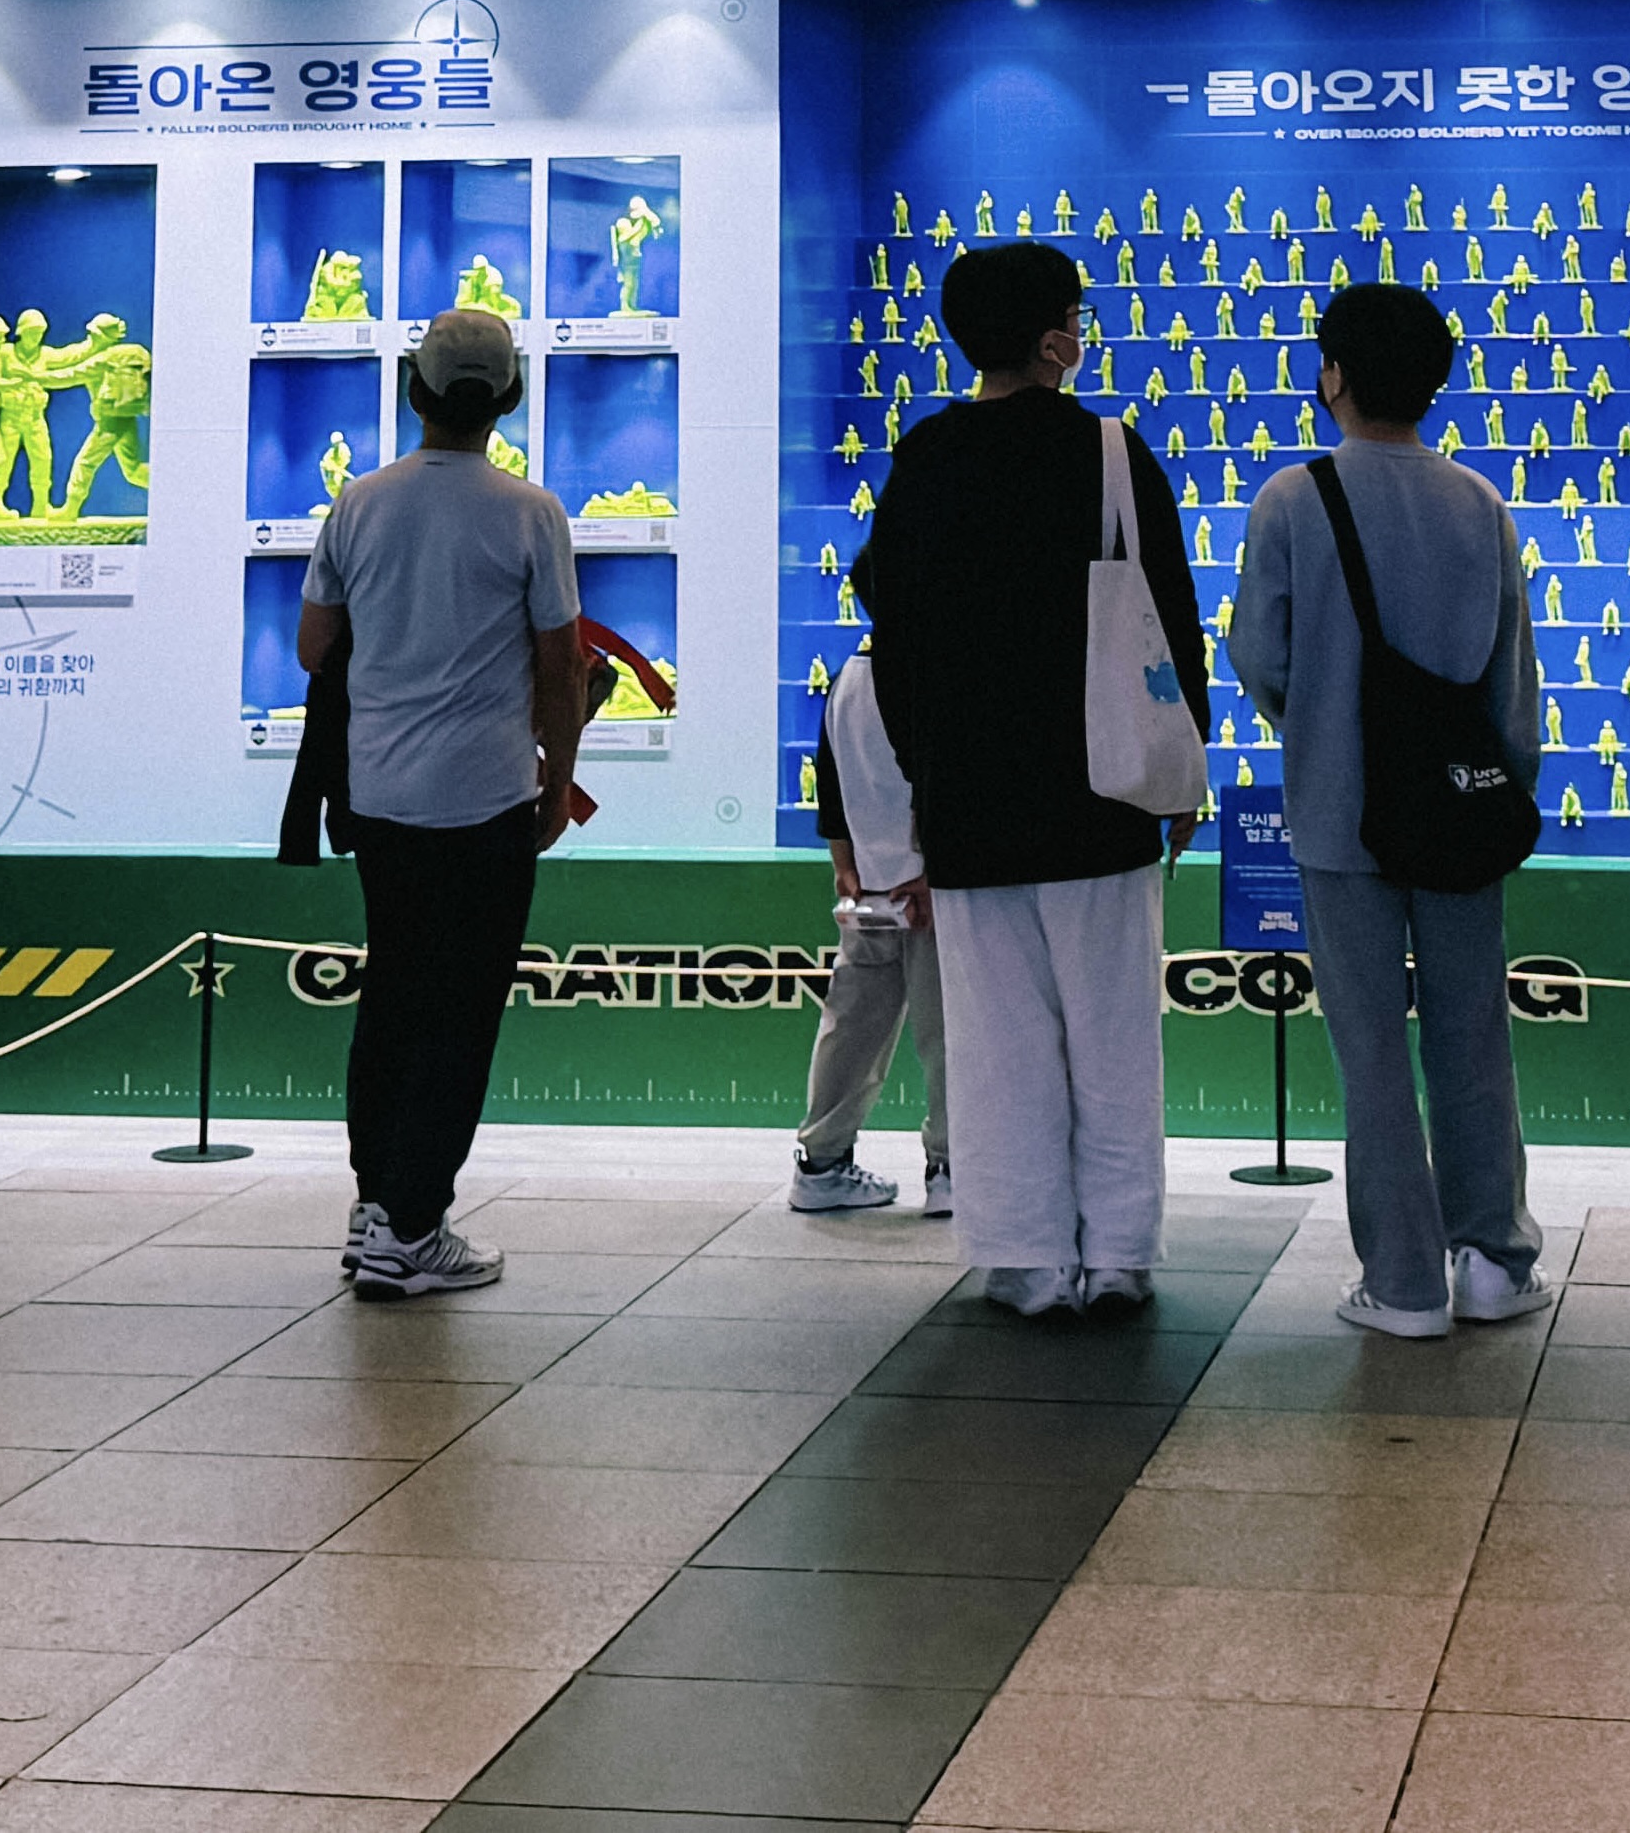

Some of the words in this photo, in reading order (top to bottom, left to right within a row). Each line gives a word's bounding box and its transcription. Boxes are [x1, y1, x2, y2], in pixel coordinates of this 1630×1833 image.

[83, 60, 275, 115] 돌아온
[299, 58, 493, 112] 영웅들
[1203, 68, 1434, 116] 돌아오지
[1456, 64, 1575, 113] 못한
[161, 125, 215, 134] FALLEN
[218, 124, 290, 133] SOLDIERS
[292, 122, 365, 132] BROUGHT
[369, 121, 413, 131] HOME
[1294, 128, 1343, 140] OVER
[1418, 126, 1504, 139] SOLDIERS
[1505, 126, 1541, 138] YET
[1542, 125, 1568, 137] TO
[1570, 124, 1622, 137] COME
[5, 654, 55, 674] 이름을
[61, 654, 94, 673] 찾아
[17, 677, 85, 697] 귀환까지
[288, 942, 839, 1009] ORATION
